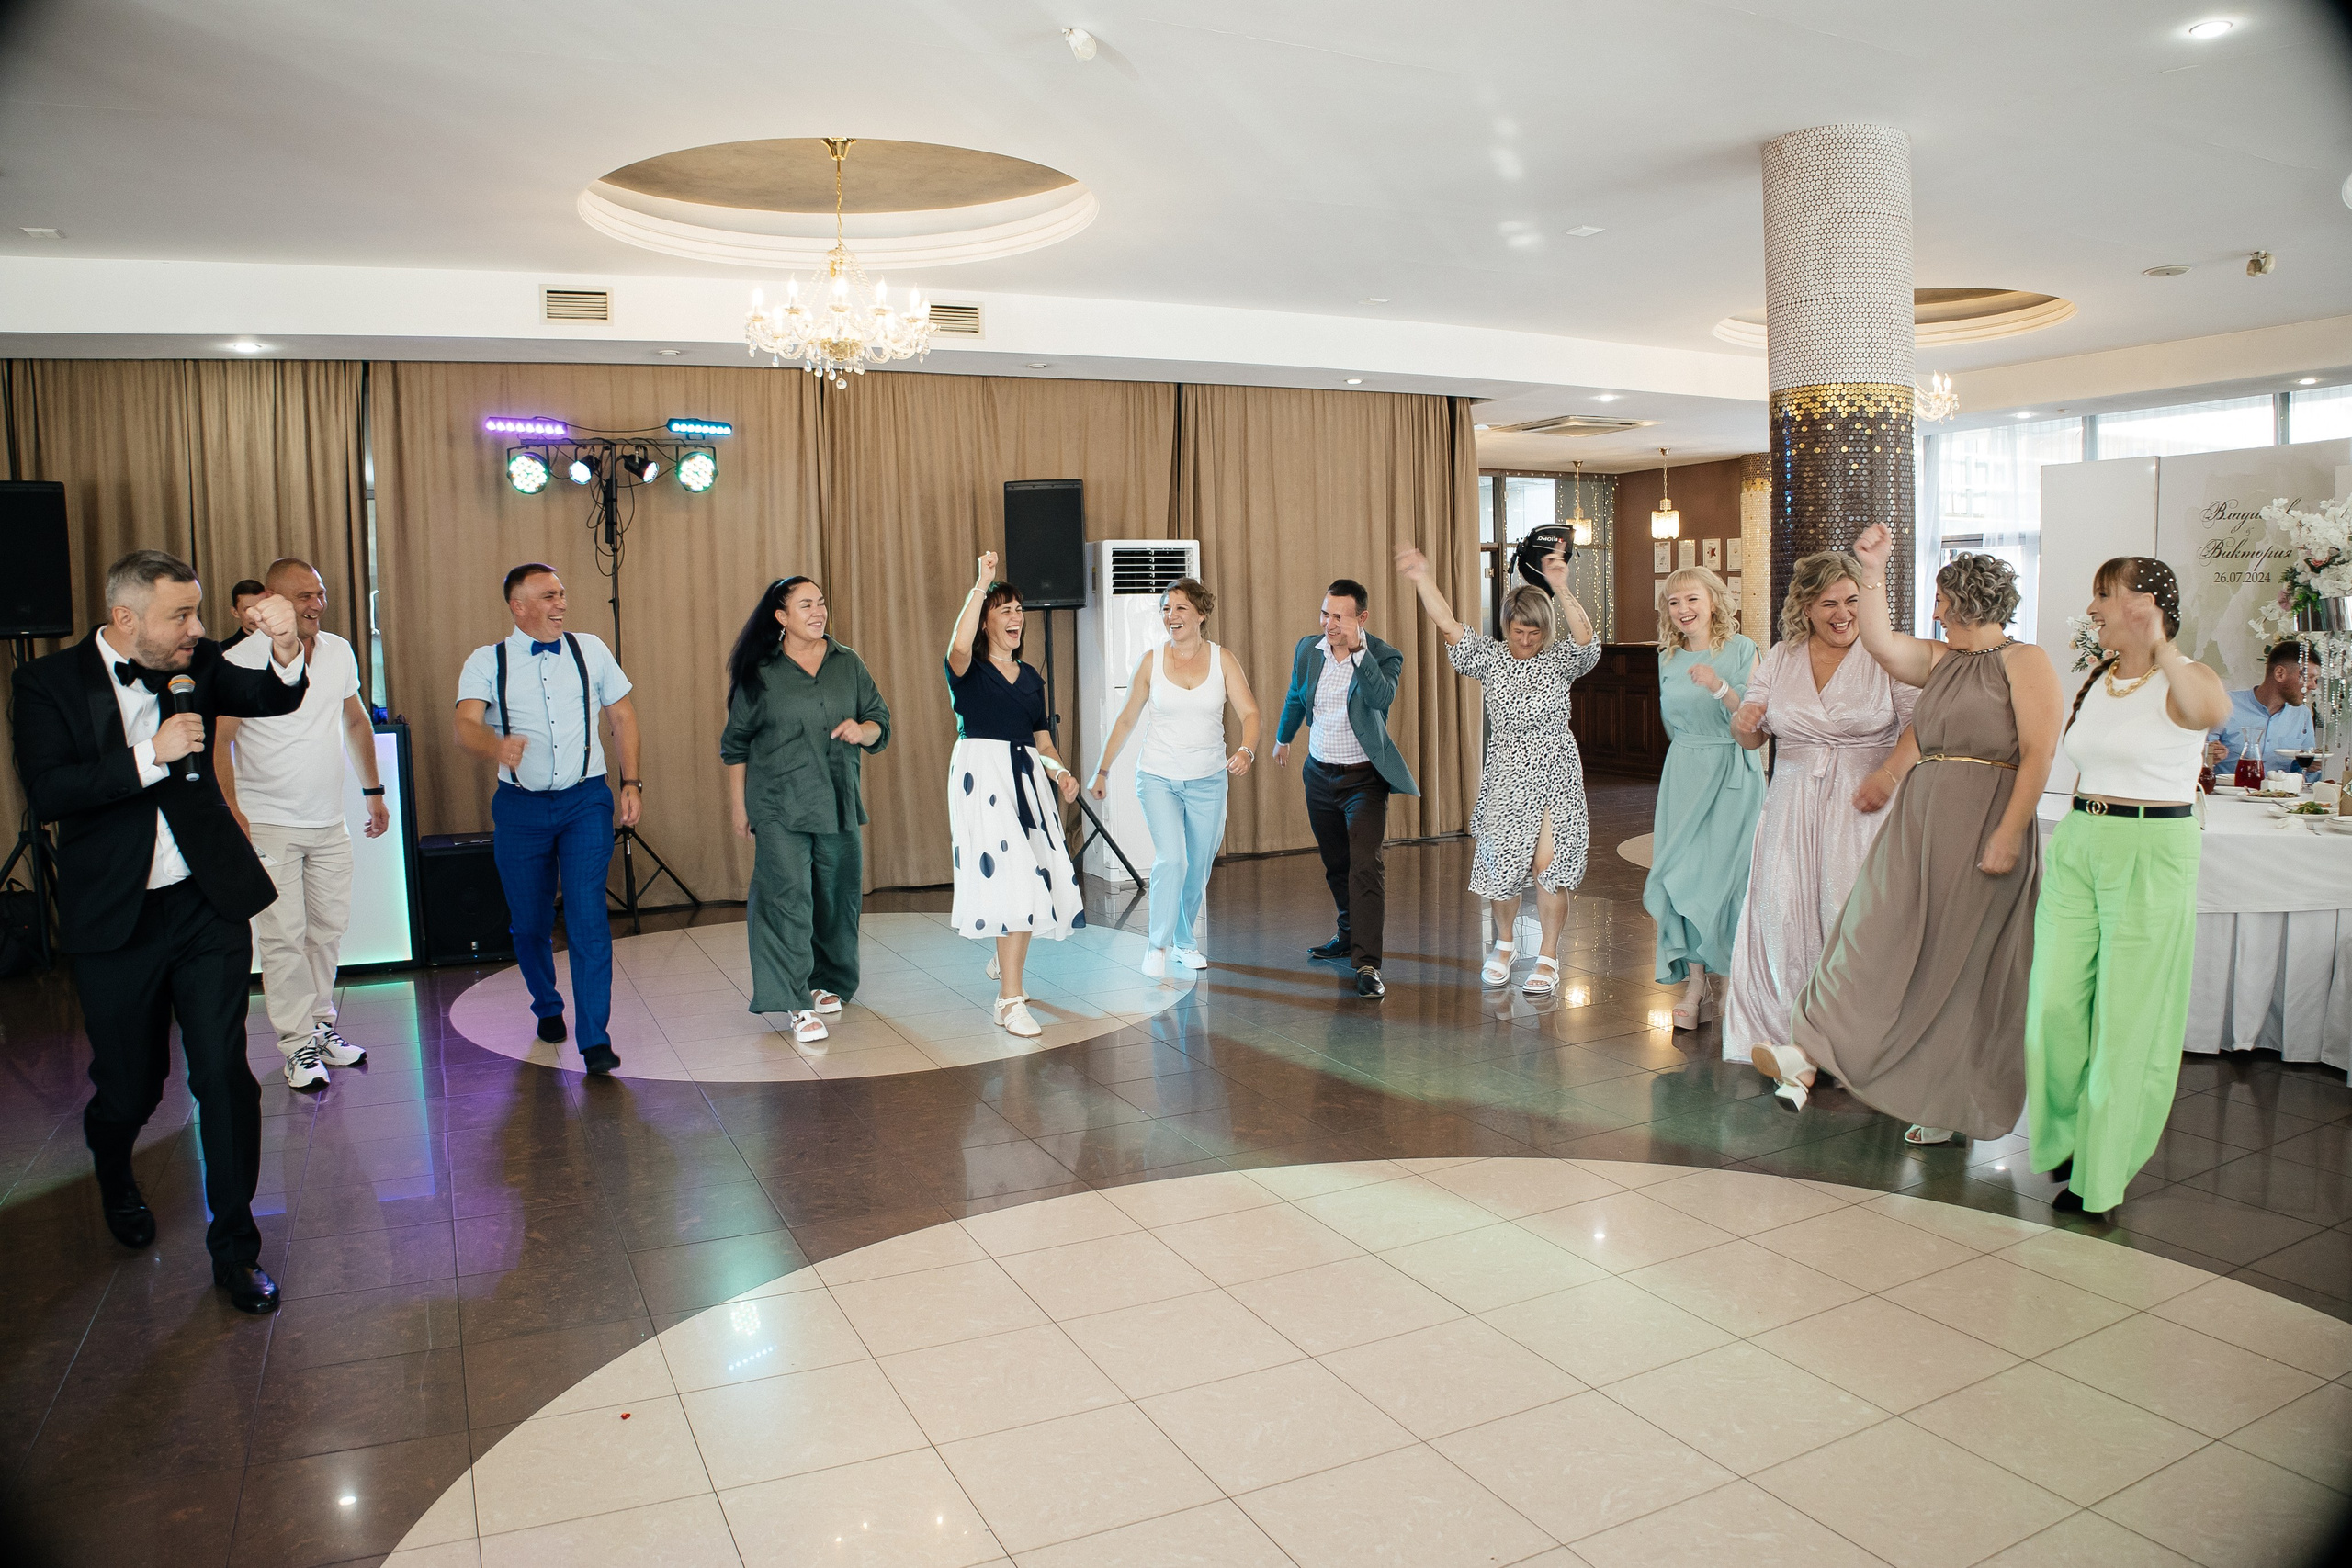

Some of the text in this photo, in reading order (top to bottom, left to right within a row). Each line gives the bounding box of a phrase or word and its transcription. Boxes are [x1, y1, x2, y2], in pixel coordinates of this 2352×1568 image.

[2199, 497, 2302, 534] Влади
[2197, 537, 2293, 571] Виктория
[2213, 572, 2271, 583] 26.07.2024
